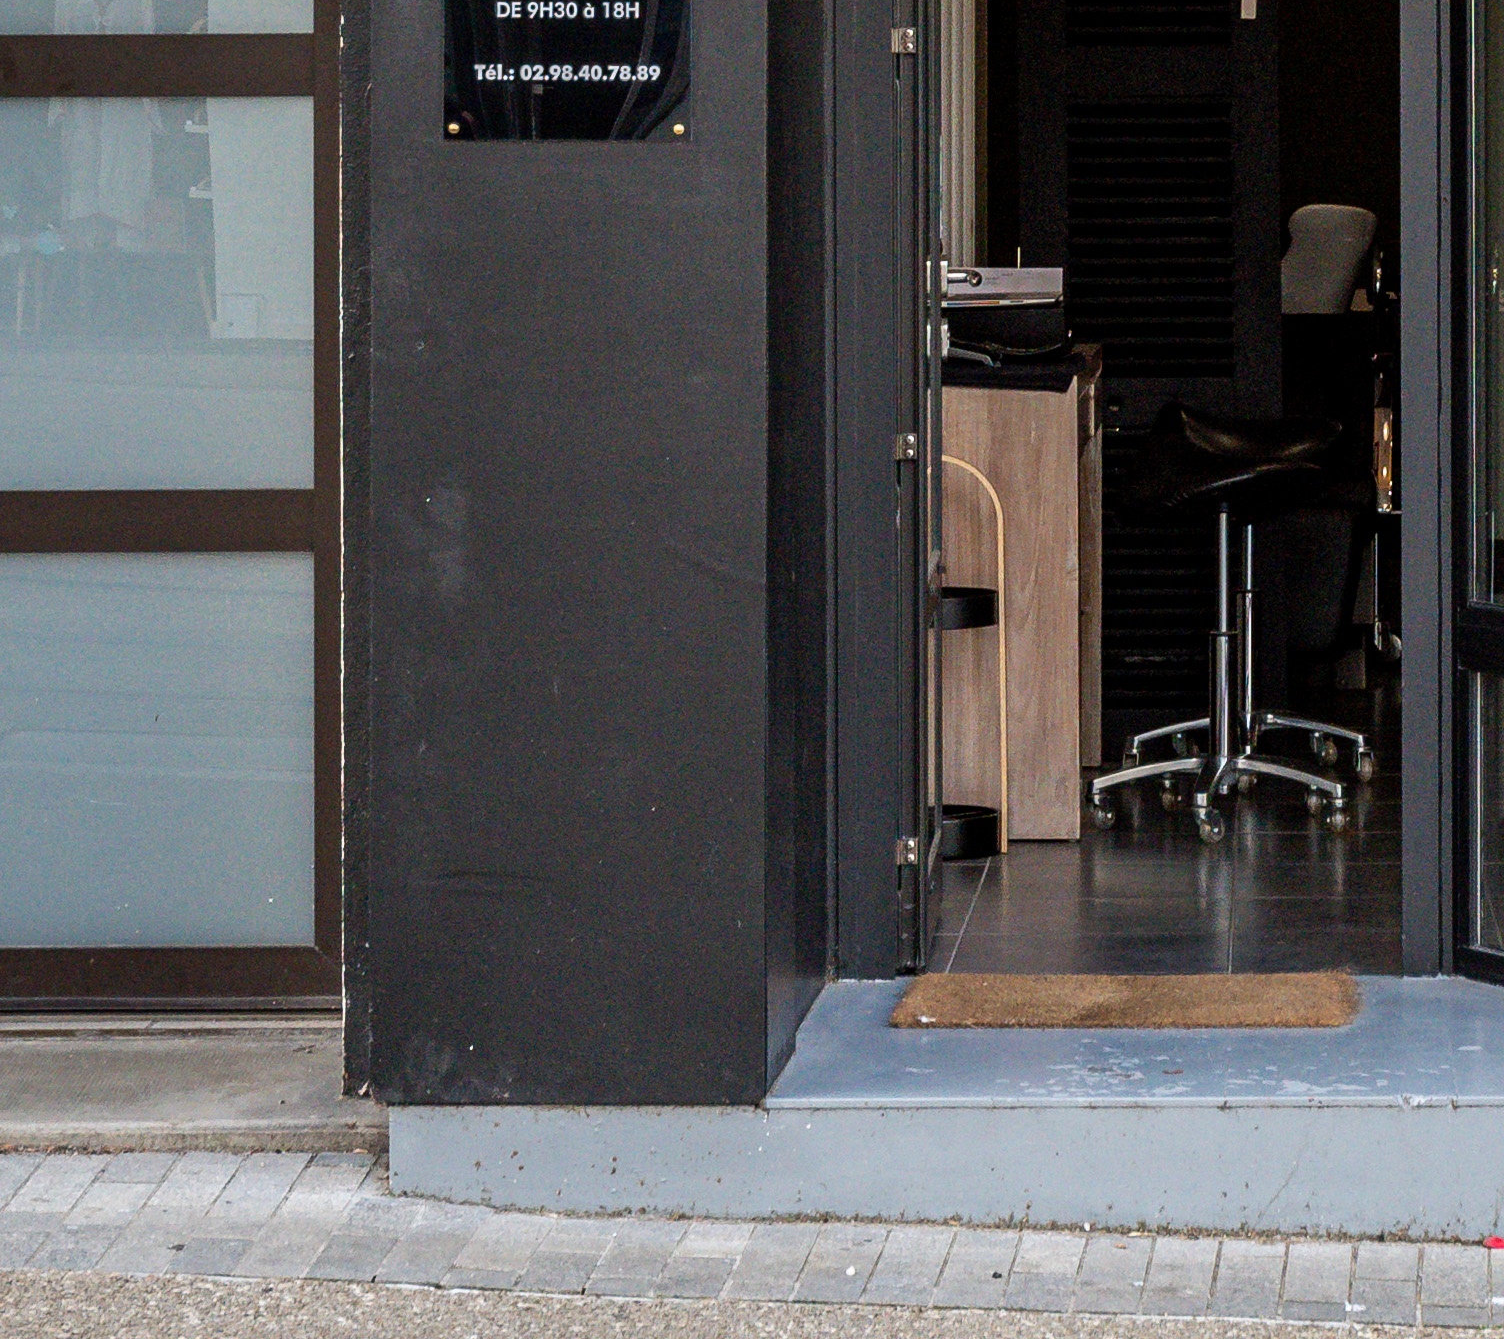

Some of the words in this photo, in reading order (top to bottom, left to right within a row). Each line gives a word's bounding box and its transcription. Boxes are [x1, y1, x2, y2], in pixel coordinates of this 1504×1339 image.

[496, 1, 522, 18] DE
[527, 1, 578, 19] 9H30
[583, 2, 595, 19] à
[602, 1, 640, 19] 18H
[519, 64, 661, 82] 02.98.40.78.89
